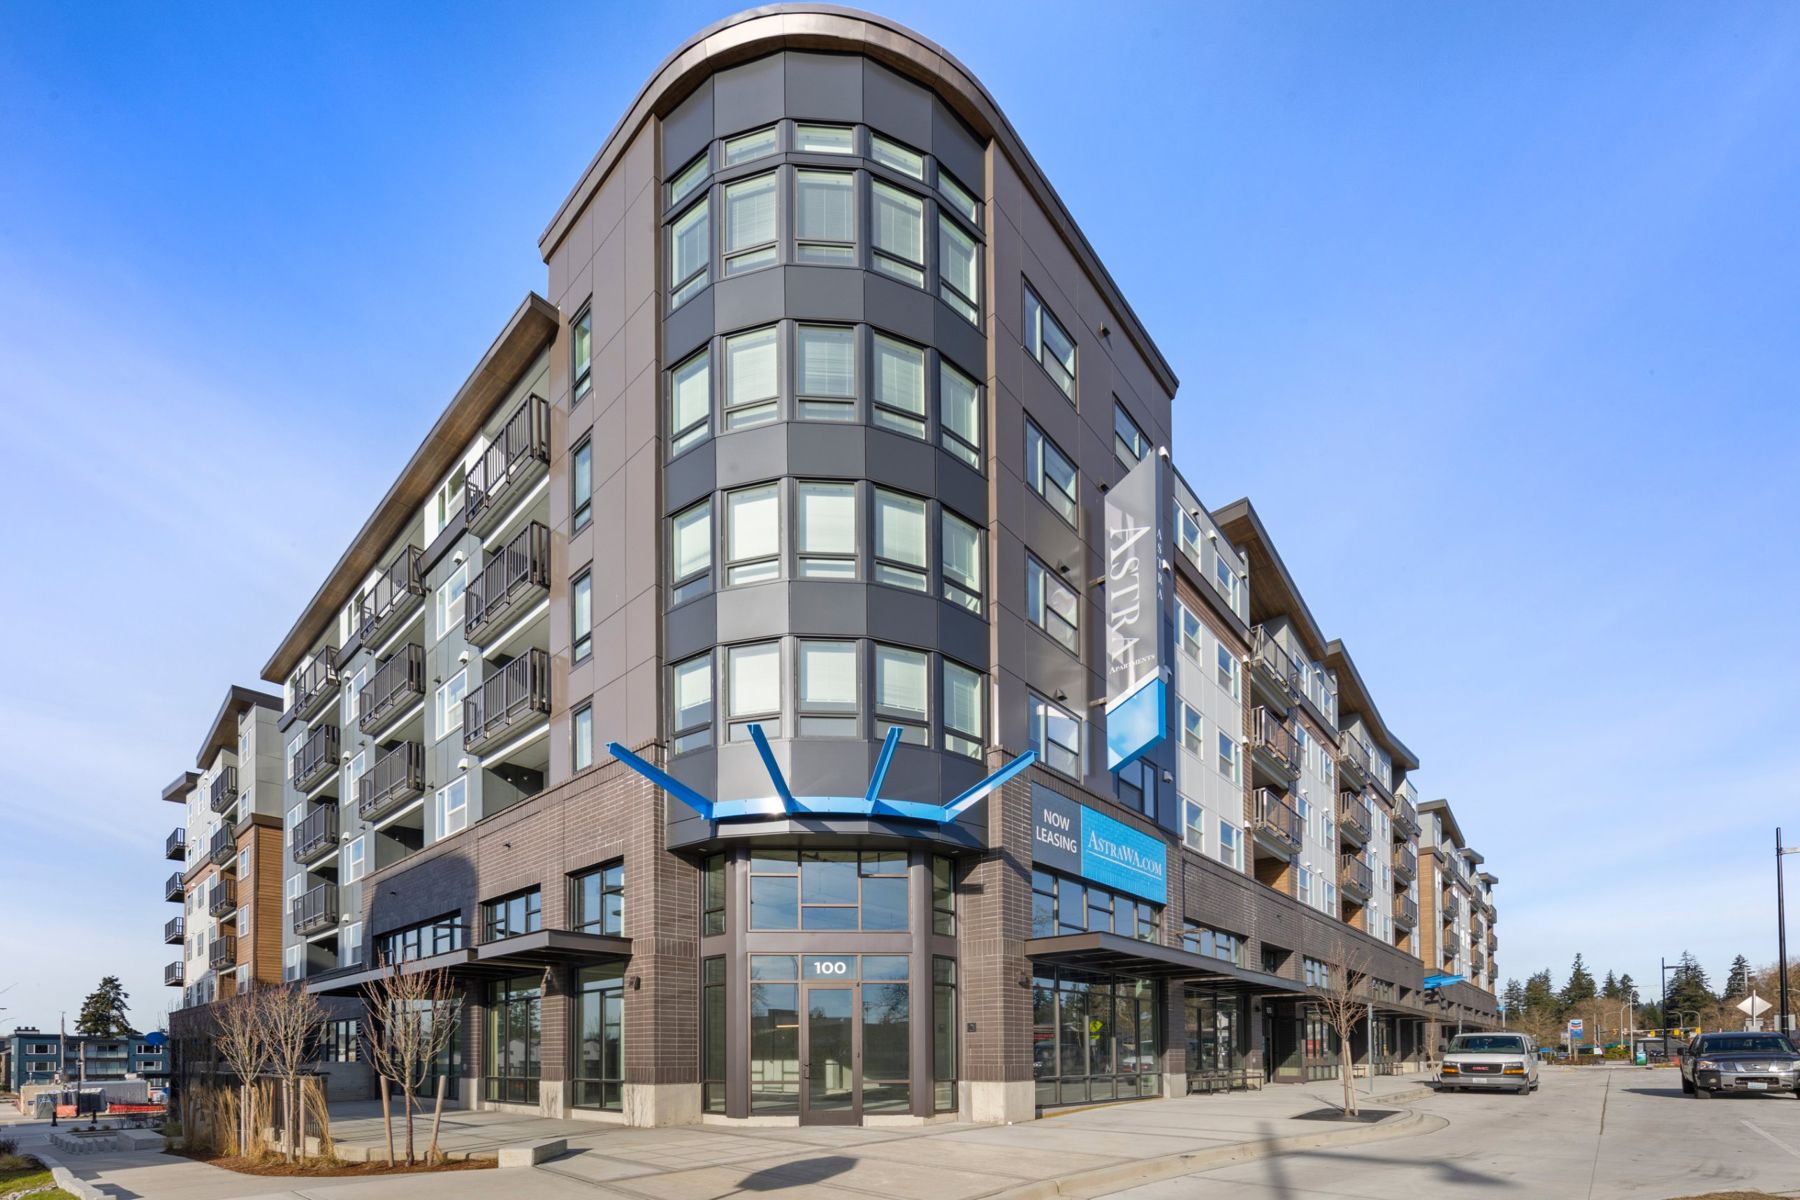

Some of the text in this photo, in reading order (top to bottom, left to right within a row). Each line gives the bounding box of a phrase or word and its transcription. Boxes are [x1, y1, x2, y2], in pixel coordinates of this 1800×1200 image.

[1110, 526, 1151, 662] ASTRA
[1109, 654, 1155, 675] APARTMENTS
[1043, 808, 1070, 832] NOW
[1036, 826, 1077, 854] LEASING
[813, 961, 846, 975] 100
